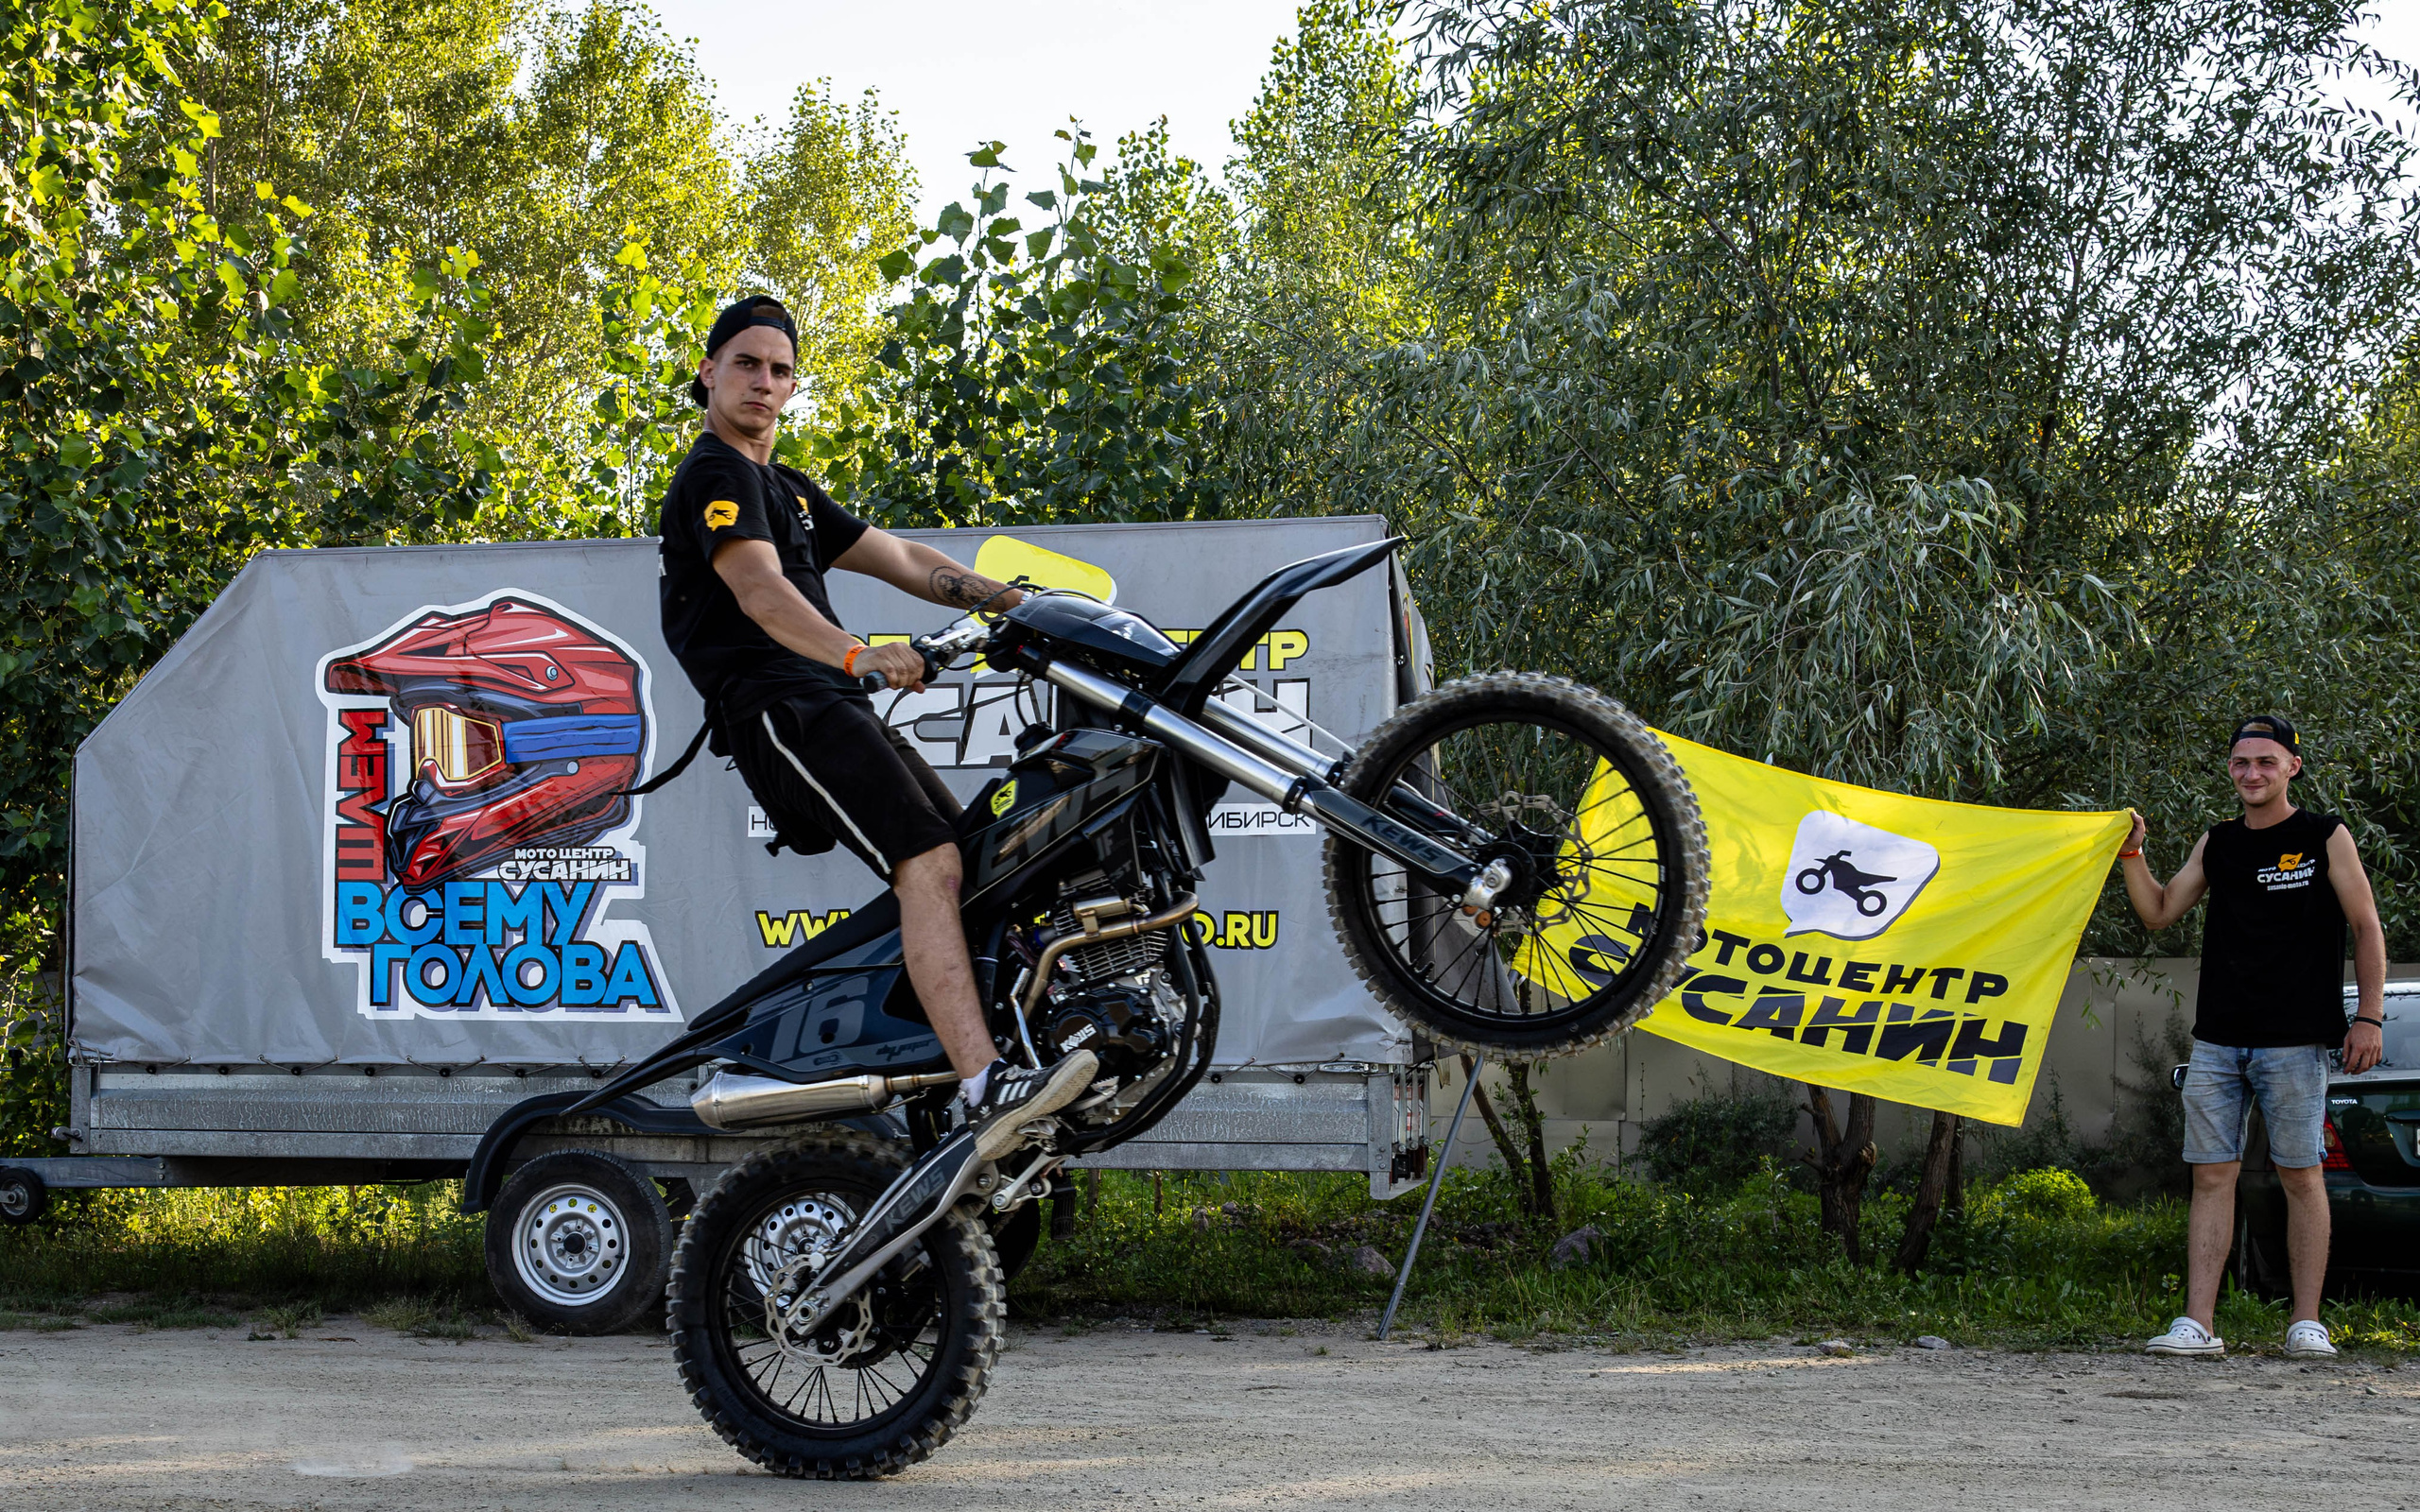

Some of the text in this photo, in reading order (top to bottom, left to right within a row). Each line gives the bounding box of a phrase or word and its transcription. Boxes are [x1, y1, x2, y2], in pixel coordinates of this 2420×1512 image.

[336, 707, 389, 882] ШЛЕМ
[498, 859, 631, 881] СУСАНИН
[1359, 815, 1443, 862] KEWS
[334, 880, 597, 948] ВСЕМУ
[370, 939, 663, 1008] ГОЛОВА
[769, 976, 870, 1062] 16
[1568, 934, 2029, 1085] ССАНИН
[884, 1165, 946, 1235] KEWS
